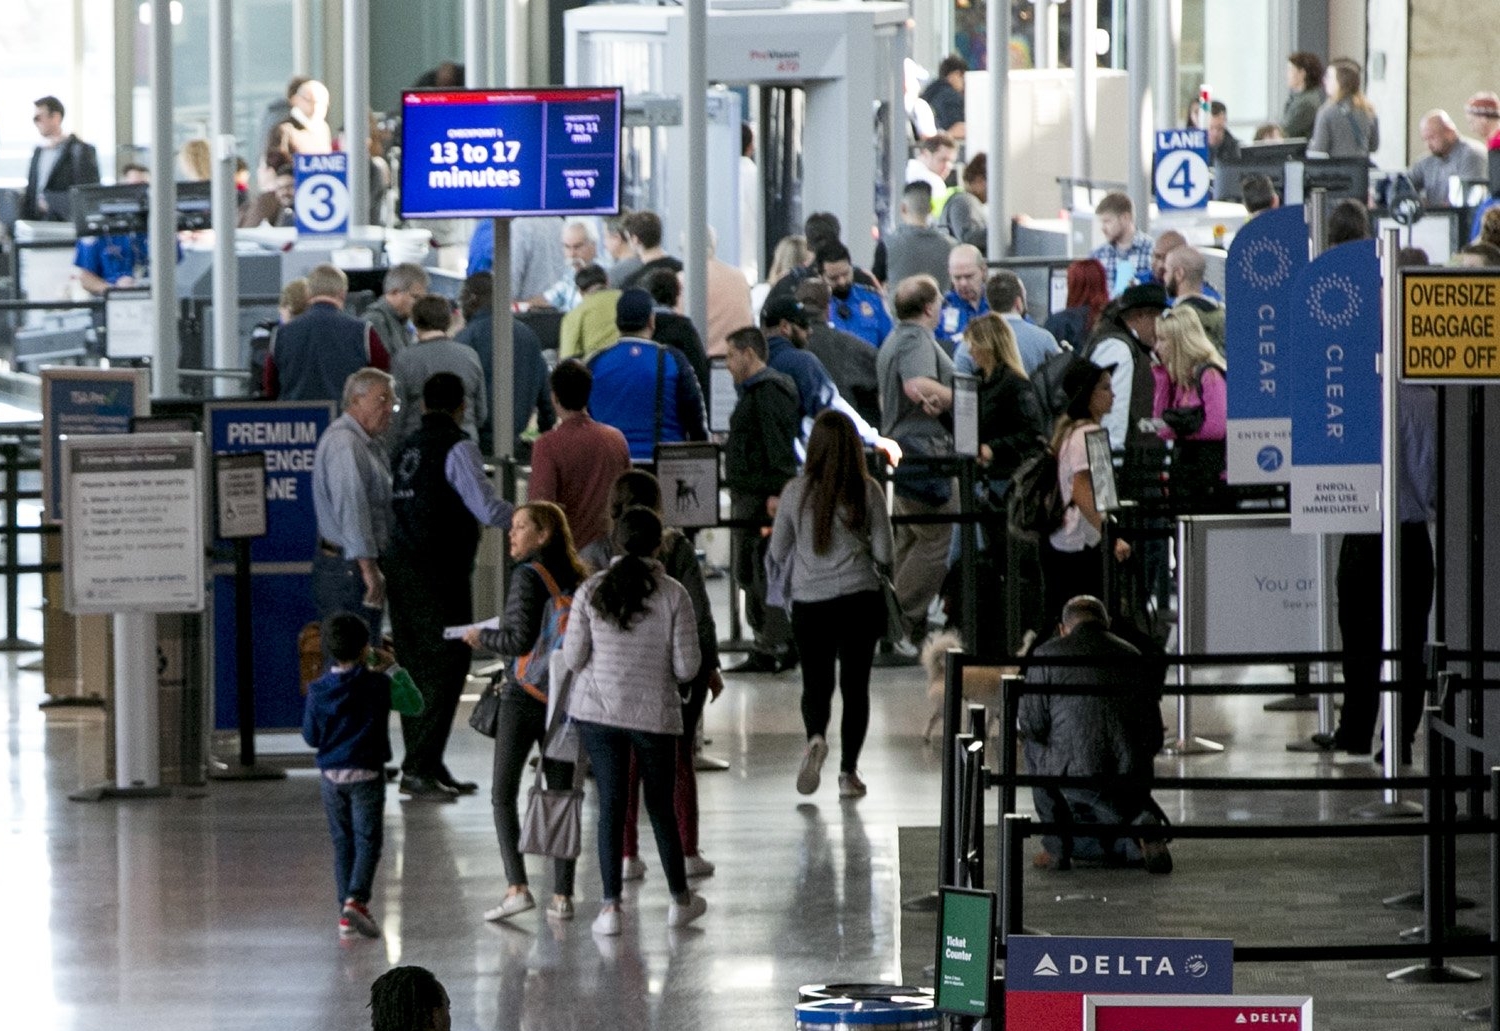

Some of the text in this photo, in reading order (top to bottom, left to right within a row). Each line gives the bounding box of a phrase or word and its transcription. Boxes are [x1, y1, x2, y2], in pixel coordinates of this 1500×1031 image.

[571, 134, 592, 144] min
[1158, 131, 1206, 149] LANE
[430, 141, 521, 164] 13 to 17
[298, 155, 346, 172] LANE
[429, 166, 521, 188] minutes
[1168, 159, 1195, 197] 4
[310, 184, 335, 222] 3
[570, 189, 591, 199] min
[1411, 283, 1496, 307] OVERSIZE
[1411, 314, 1494, 338] BAGGAGE
[1258, 304, 1276, 394] CLEAR
[1409, 345, 1497, 369] DROP OFF
[1326, 345, 1344, 438] CLEAR
[227, 421, 317, 445] PREMIUM
[1238, 431, 1270, 440] ENTER
[1316, 483, 1356, 492] ENROLL
[1313, 494, 1358, 503] AND USE
[1302, 505, 1370, 514] IMMEDIATELY
[1254, 574, 1289, 592] You
[946, 935, 966, 948] Ticket
[946, 948, 972, 961] Counter
[1070, 955, 1175, 976] DELTA
[1250, 1013, 1297, 1023] DELTA
